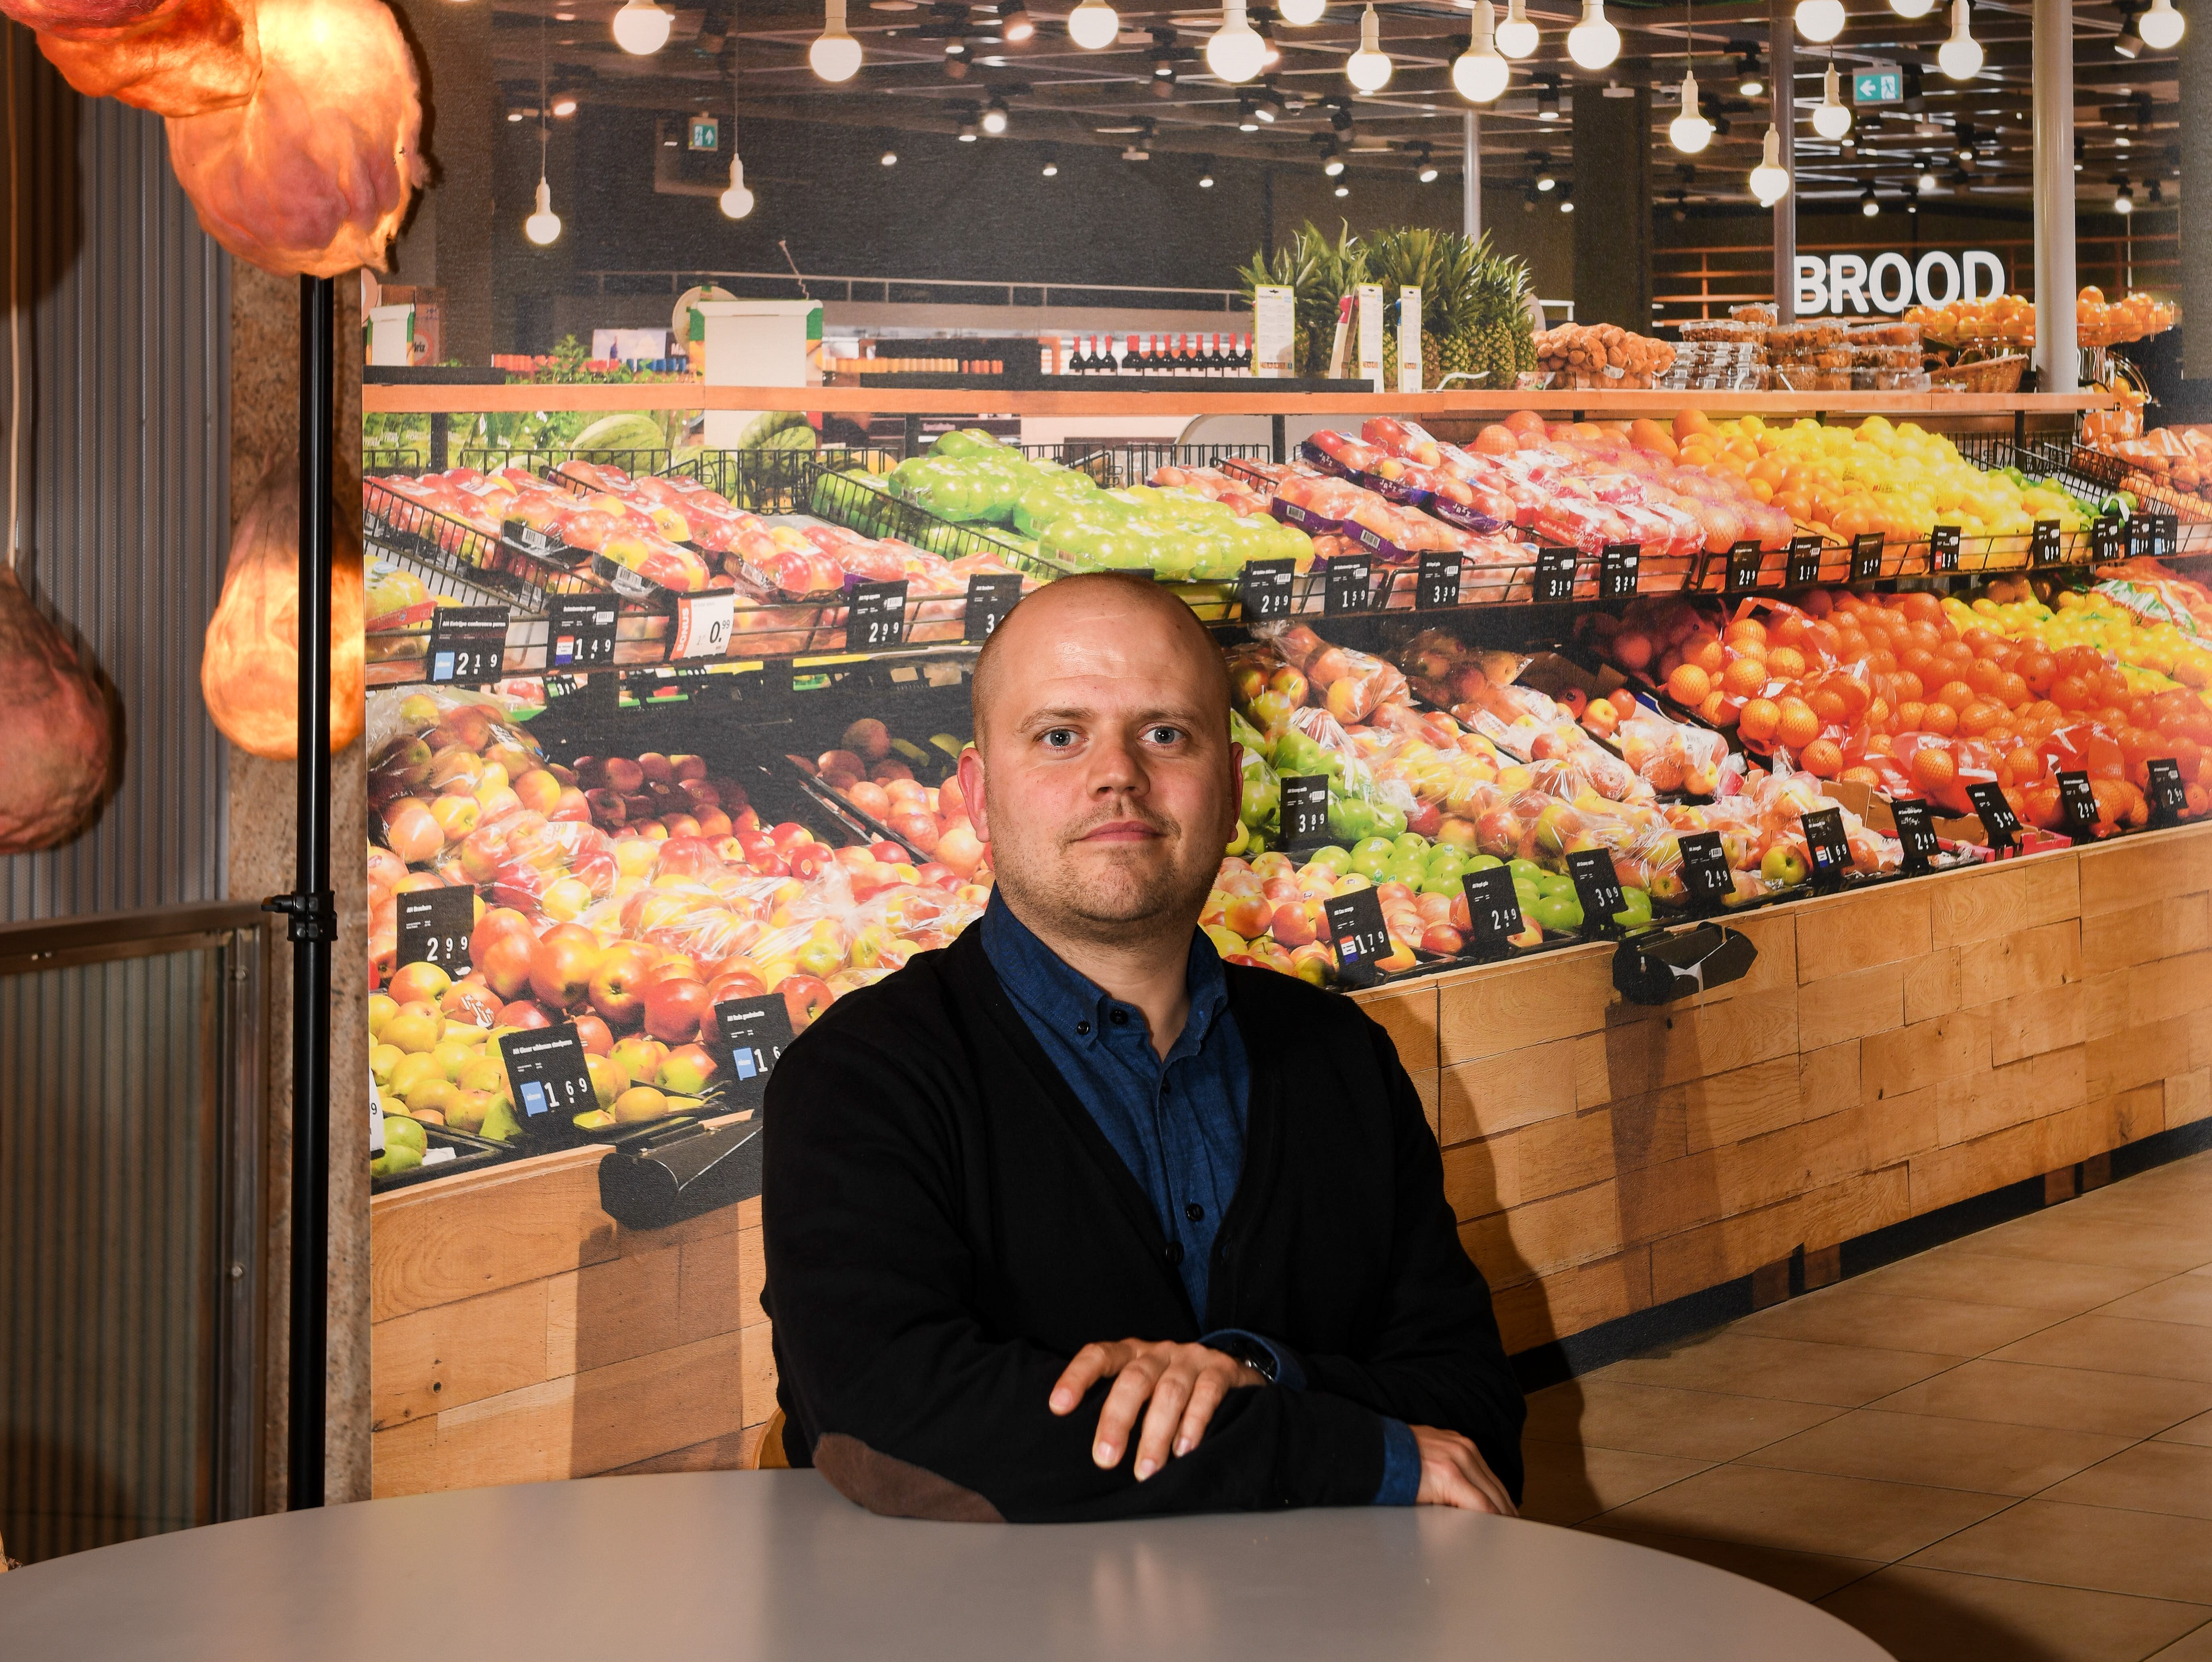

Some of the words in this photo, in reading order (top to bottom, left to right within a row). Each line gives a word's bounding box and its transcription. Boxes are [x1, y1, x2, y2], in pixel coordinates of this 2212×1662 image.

[1794, 250, 2005, 314] BROOD
[1453, 503, 1471, 518] JAZZ
[1434, 585, 1456, 603] 3.39
[1550, 579, 1571, 596] 3.19
[1615, 575, 1635, 593] 3.29
[1261, 595, 1288, 613] 2.89
[1342, 590, 1365, 608] 1.59
[710, 620, 730, 643] 0.99
[868, 622, 899, 643] 2.99
[575, 638, 611, 660] 1.49
[456, 652, 498, 675] 2.19
[1299, 813, 1325, 833] 3.89
[1826, 844, 1847, 864] 1.69
[1705, 870, 1728, 888] 2.49
[1595, 886, 1618, 907] 3.09
[1492, 908, 1517, 930] 2.49
[427, 936, 468, 962] 2.99
[1355, 931, 1384, 955] 1.79
[544, 1077, 588, 1108] 1.69
